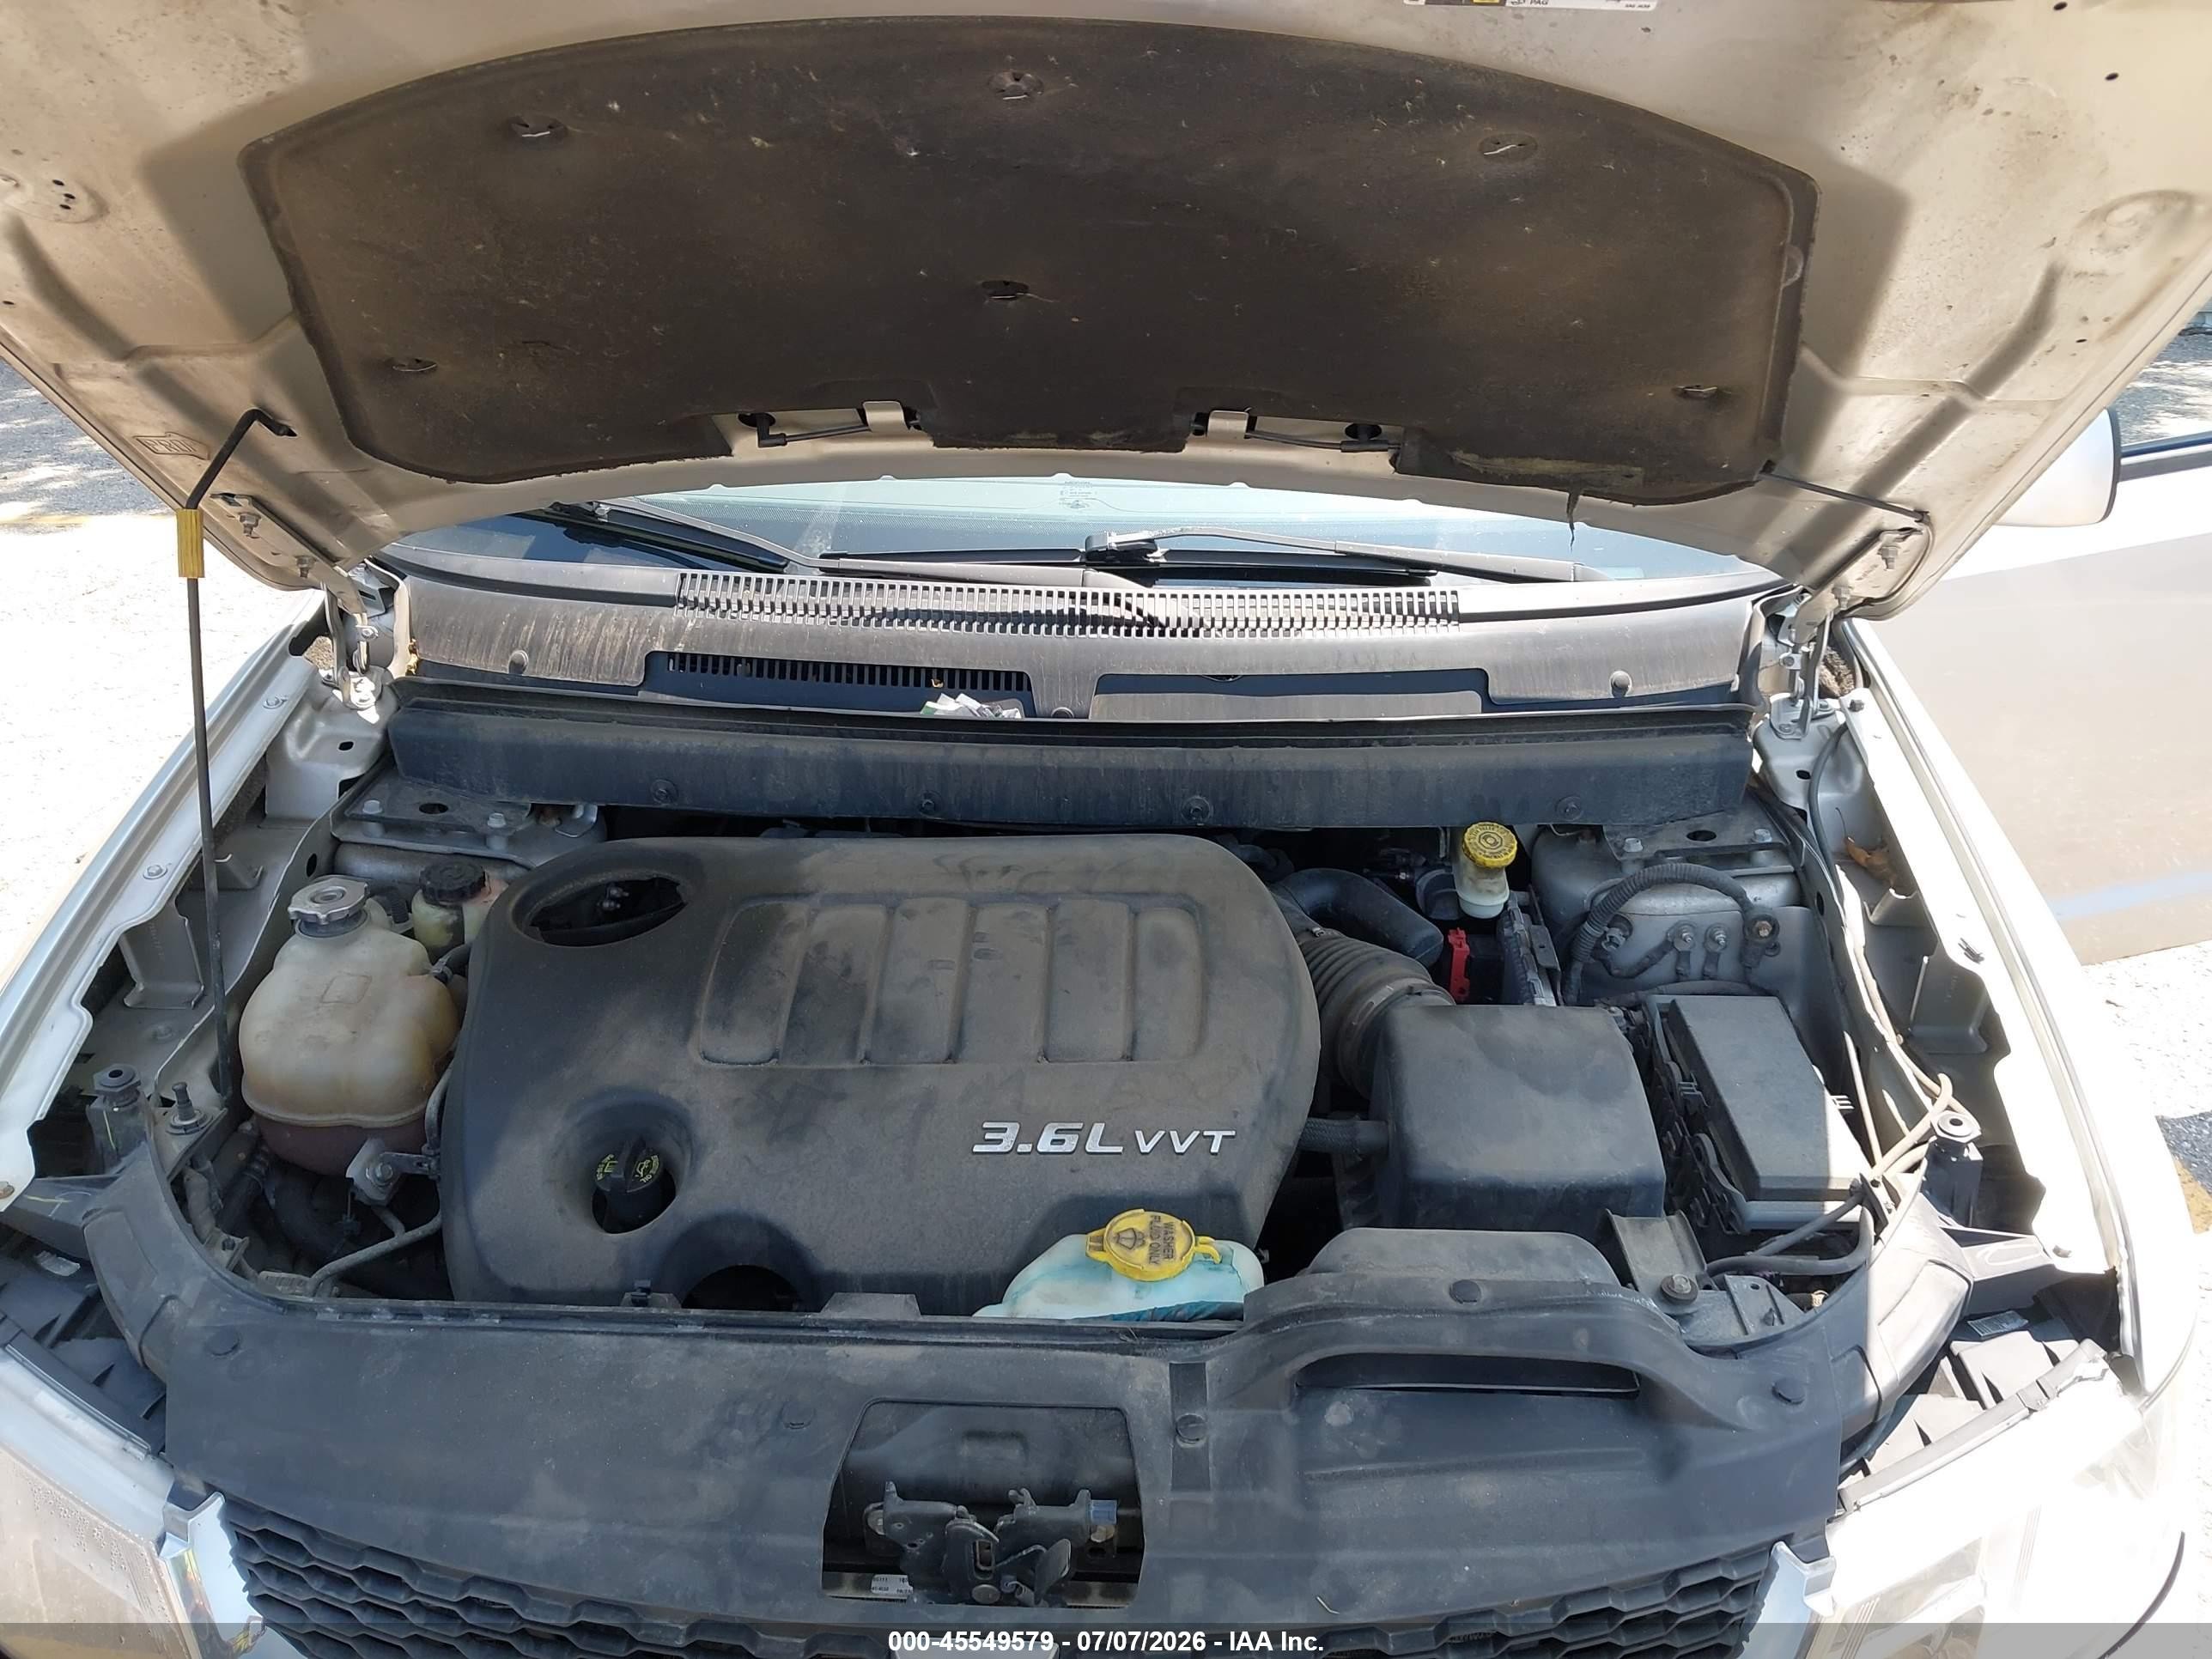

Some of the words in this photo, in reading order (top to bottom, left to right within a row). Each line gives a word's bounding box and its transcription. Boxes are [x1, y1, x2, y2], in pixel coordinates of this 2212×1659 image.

[973, 1121, 1123, 1155] 3.6L
[1134, 1130, 1237, 1156] VVT
[1148, 1242, 1161, 1265] ONLY
[1163, 1221, 1176, 1260] WASHER
